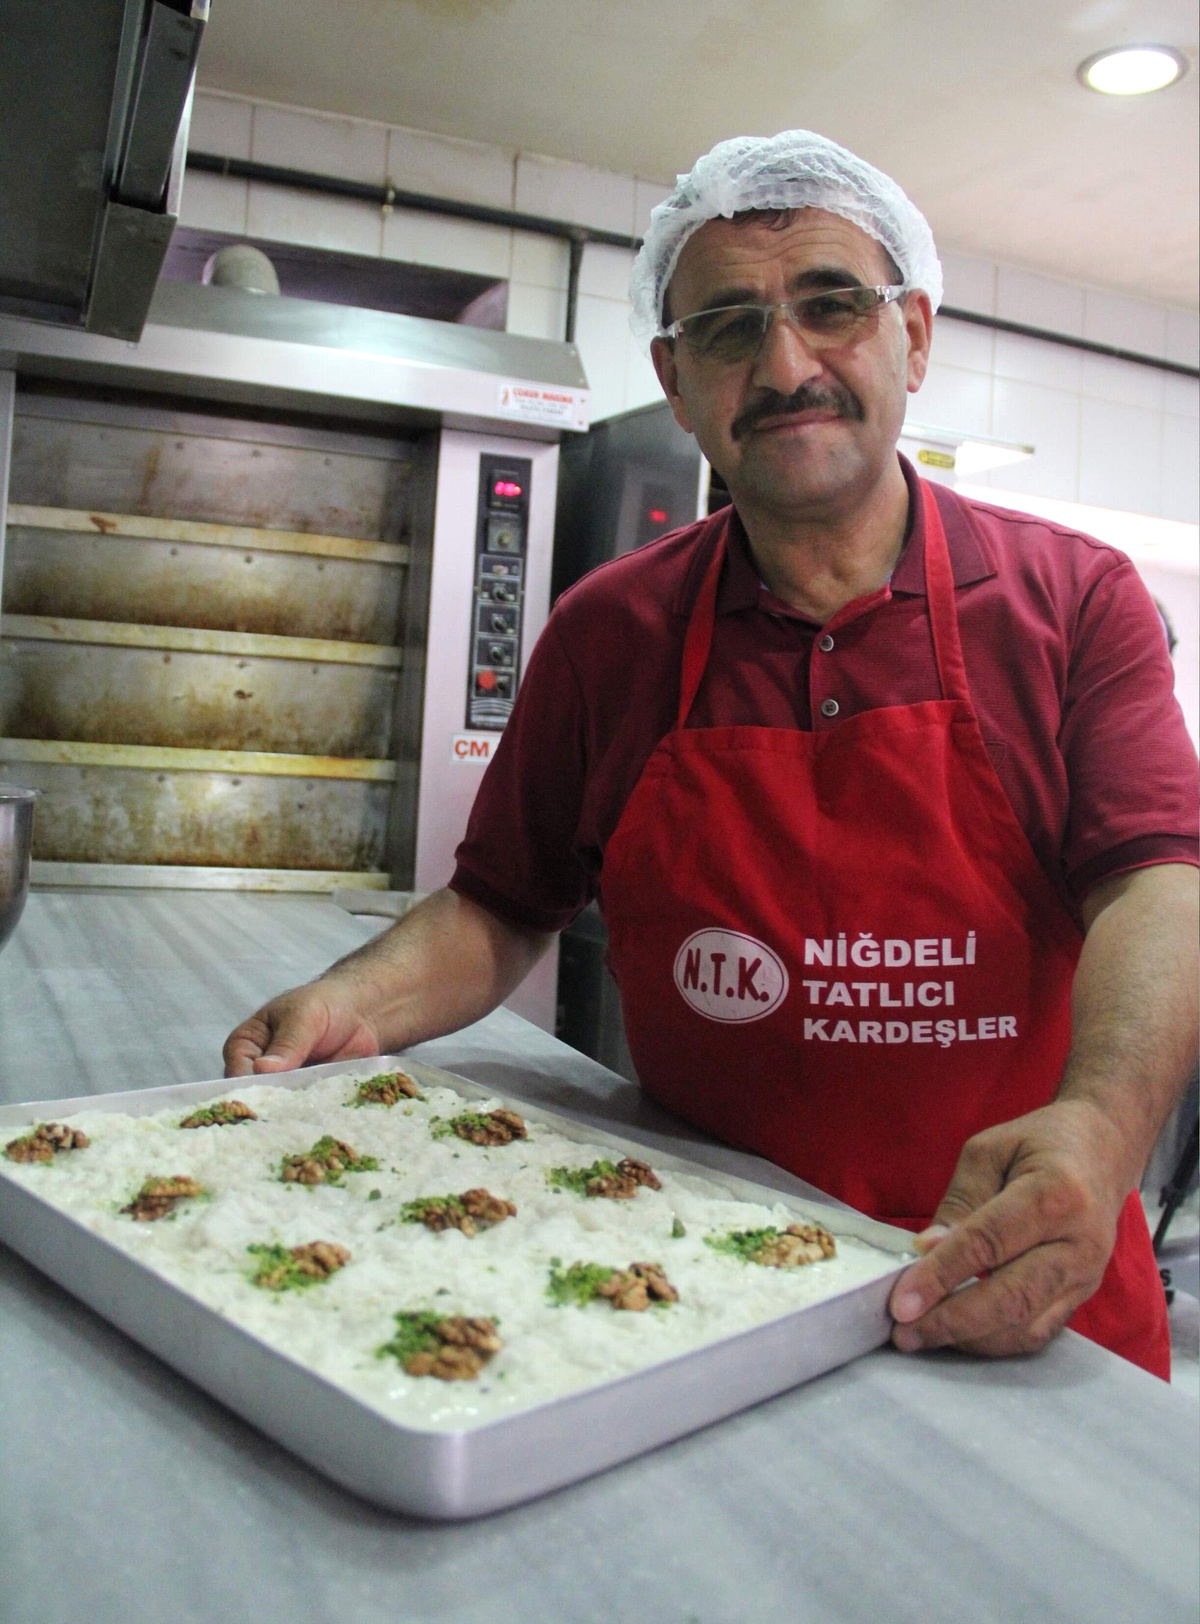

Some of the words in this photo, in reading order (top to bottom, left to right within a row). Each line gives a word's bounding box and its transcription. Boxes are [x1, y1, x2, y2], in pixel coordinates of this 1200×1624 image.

[454, 739, 489, 759] ÇM
[804, 930, 977, 968] NİĞDELİ
[683, 948, 770, 1002] N.T.K.
[802, 980, 955, 1008] TATLICI
[803, 1015, 1018, 1048] KARDEŞLER
